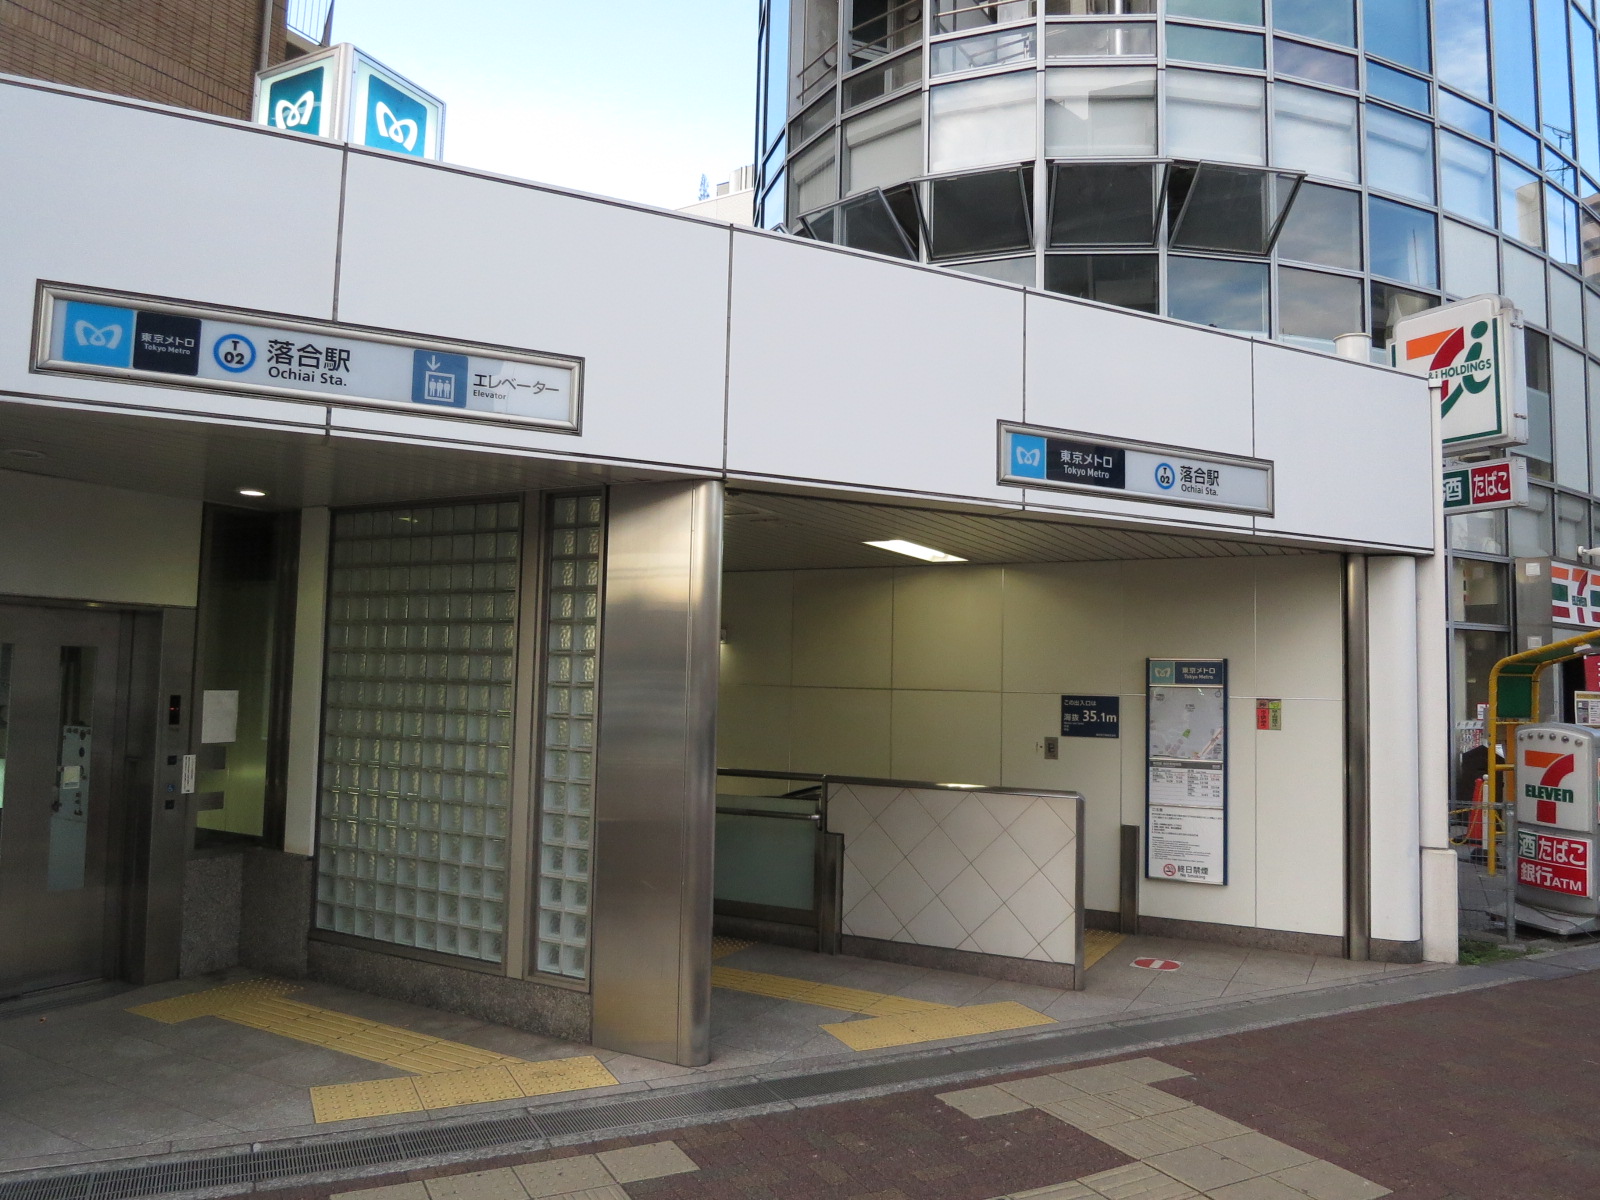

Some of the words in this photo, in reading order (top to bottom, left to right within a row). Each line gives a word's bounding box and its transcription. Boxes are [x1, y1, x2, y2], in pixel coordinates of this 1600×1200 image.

[141, 332, 195, 347] 東京メトロ
[231, 340, 240, 351] T
[144, 342, 167, 353] Tokyo
[168, 346, 191, 355] Metro
[267, 339, 351, 373] 落合駅
[224, 351, 245, 365] 02
[1441, 358, 1492, 378] HOLDINGS
[268, 366, 315, 383] Ochiai
[320, 373, 348, 387] Sta.
[473, 373, 560, 395] エレベーター
[473, 389, 507, 400] Elevator
[1060, 450, 1113, 468] 東京メトロ
[1063, 464, 1086, 477] Tokyo
[1087, 467, 1110, 479] Metro
[1162, 467, 1168, 475] T
[1180, 465, 1219, 487] 落合駅
[1160, 475, 1170, 484] 02
[1473, 471, 1510, 498] たばこ
[1181, 483, 1204, 495] Ochiai
[1205, 486, 1219, 497] Sta.
[1182, 667, 1216, 675] 東京メトロ
[1082, 709, 1117, 723] 35.1m
[1518, 832, 1536, 859] 酒
[1538, 838, 1585, 867] たばこ
